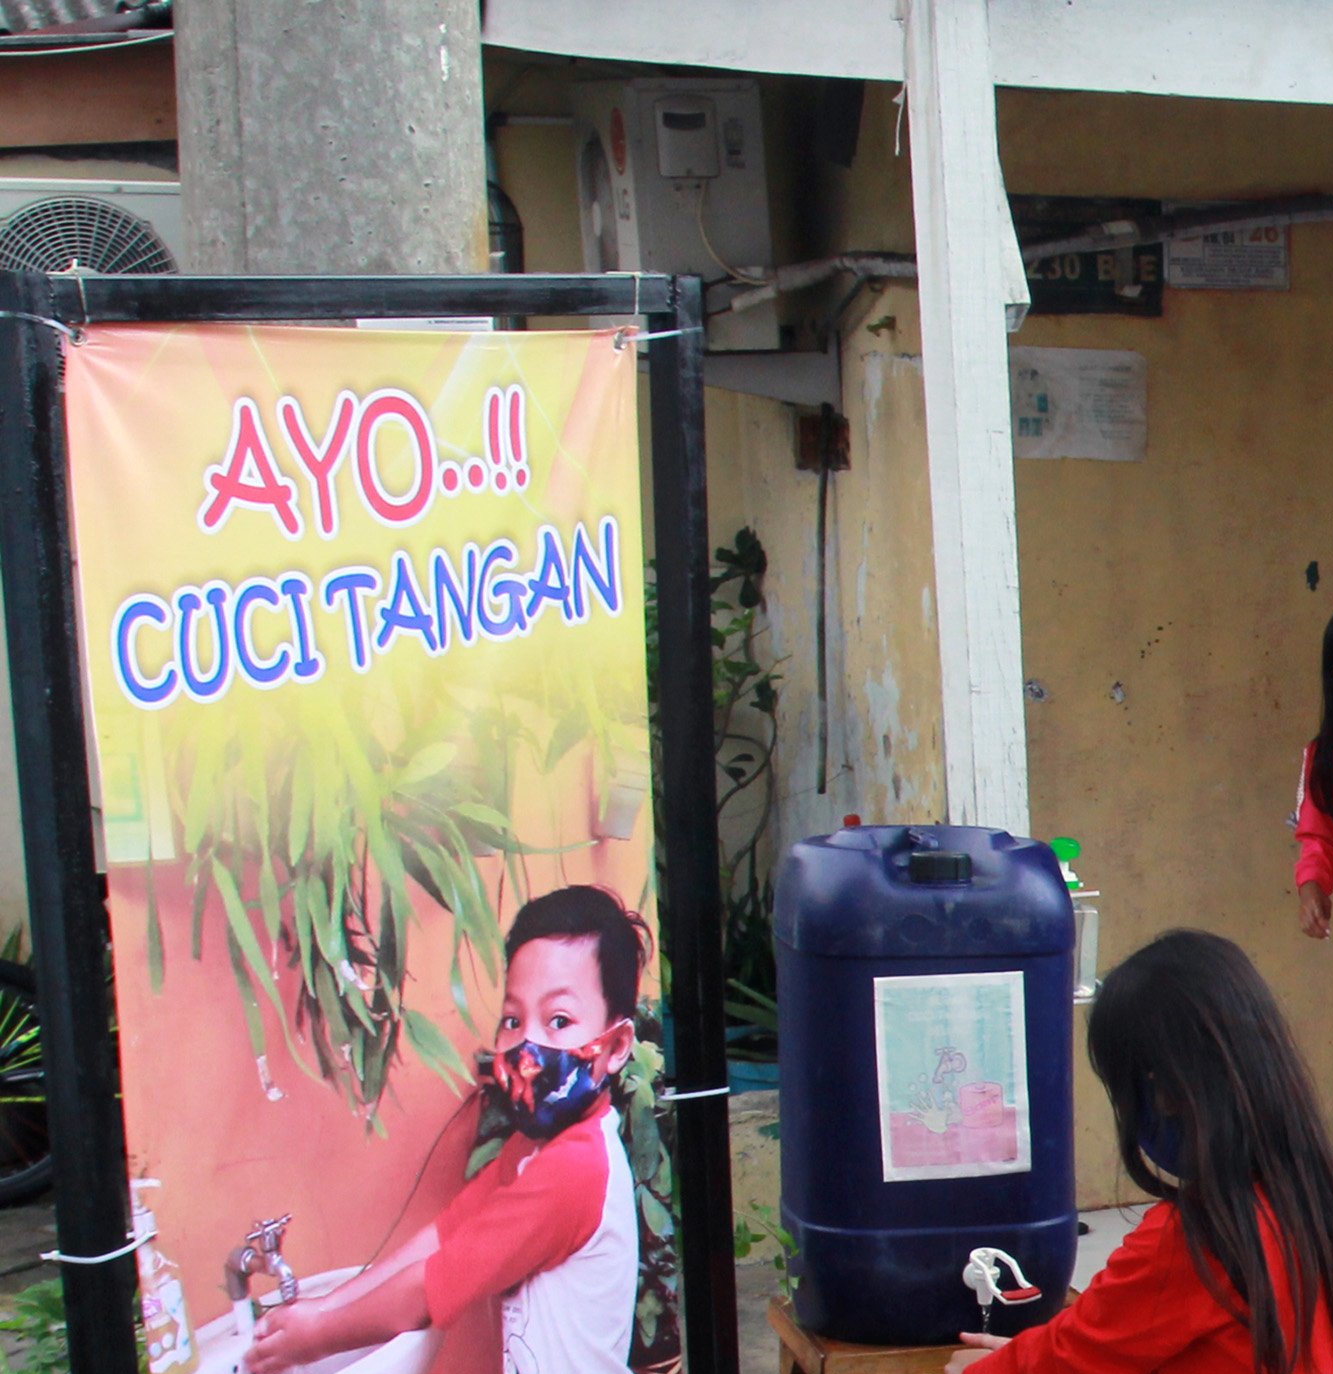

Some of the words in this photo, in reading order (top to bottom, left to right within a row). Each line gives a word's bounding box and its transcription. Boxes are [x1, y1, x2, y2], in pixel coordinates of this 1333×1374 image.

[1097, 255, 1158, 281] BE
[112, 572, 325, 709] CUCI
[322, 515, 625, 672] TANGAN
